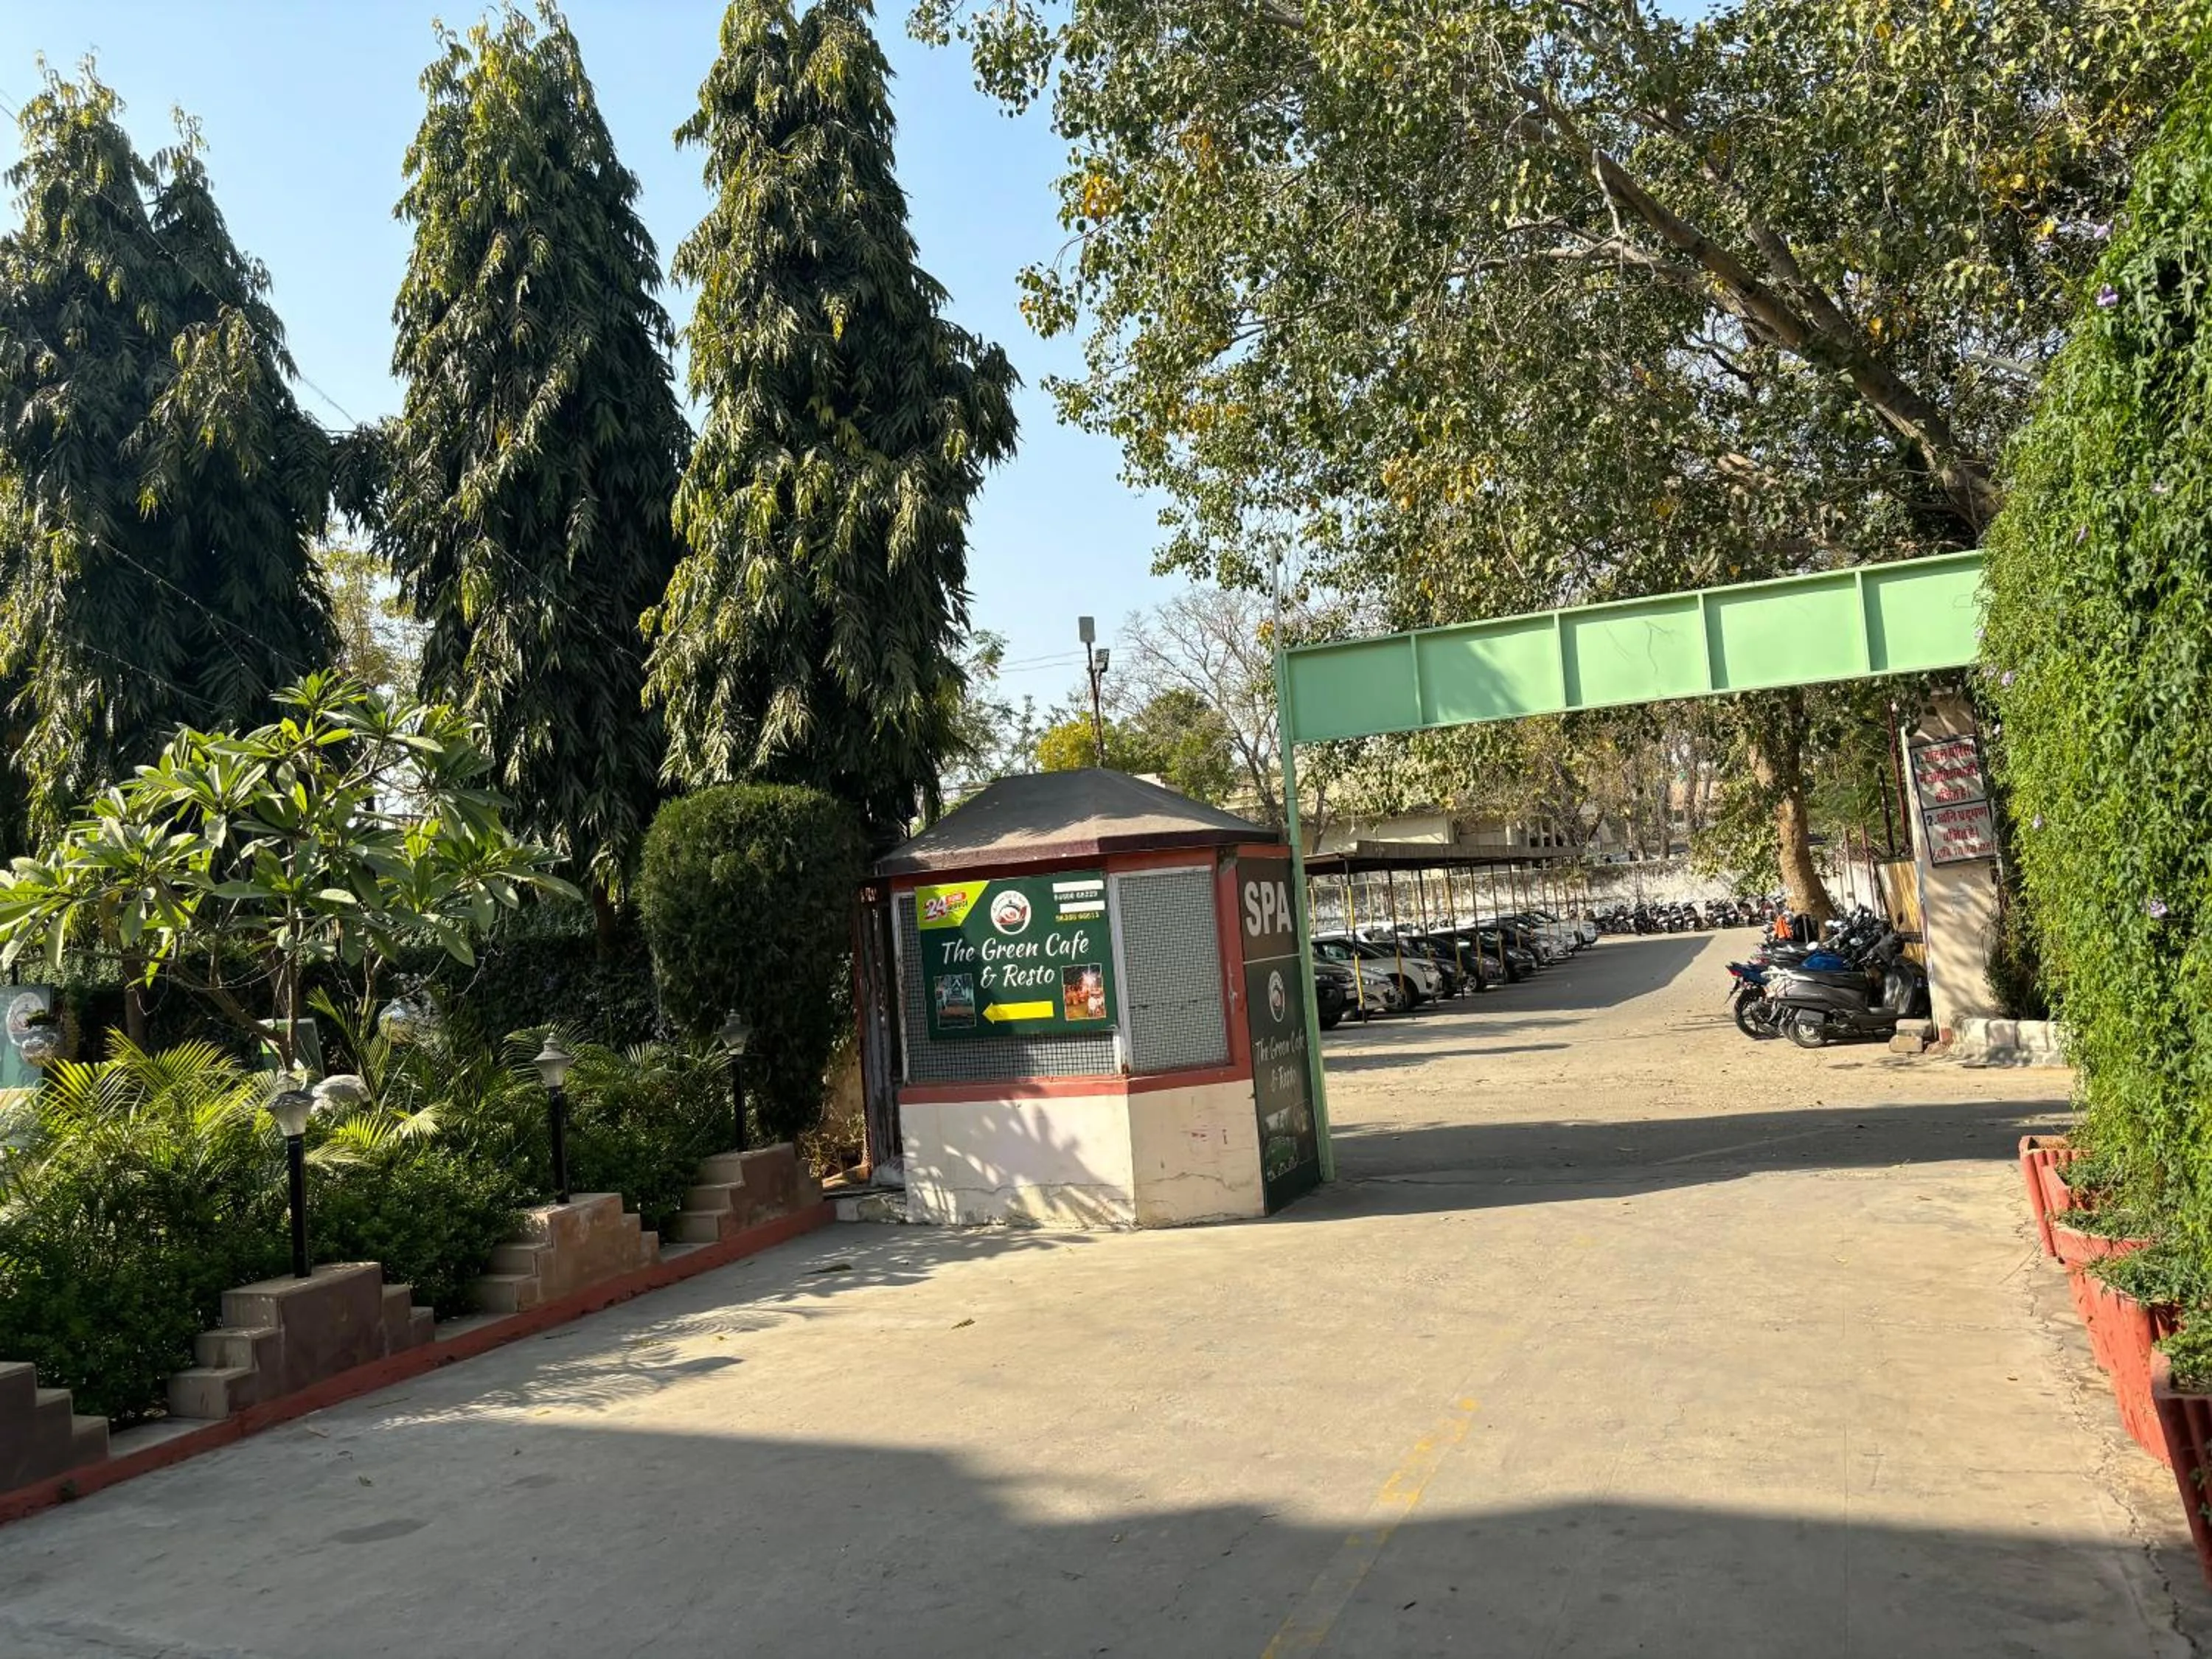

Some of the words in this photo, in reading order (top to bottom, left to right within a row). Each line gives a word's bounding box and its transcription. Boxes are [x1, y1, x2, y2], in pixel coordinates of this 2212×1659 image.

[923, 897, 947, 922] 24
[1244, 880, 1293, 937] SPA
[942, 939, 975, 964] The
[981, 937, 1038, 961] Green
[1045, 930, 1090, 960] Cafe
[980, 965, 997, 989] &
[1002, 964, 1055, 987] Resto
